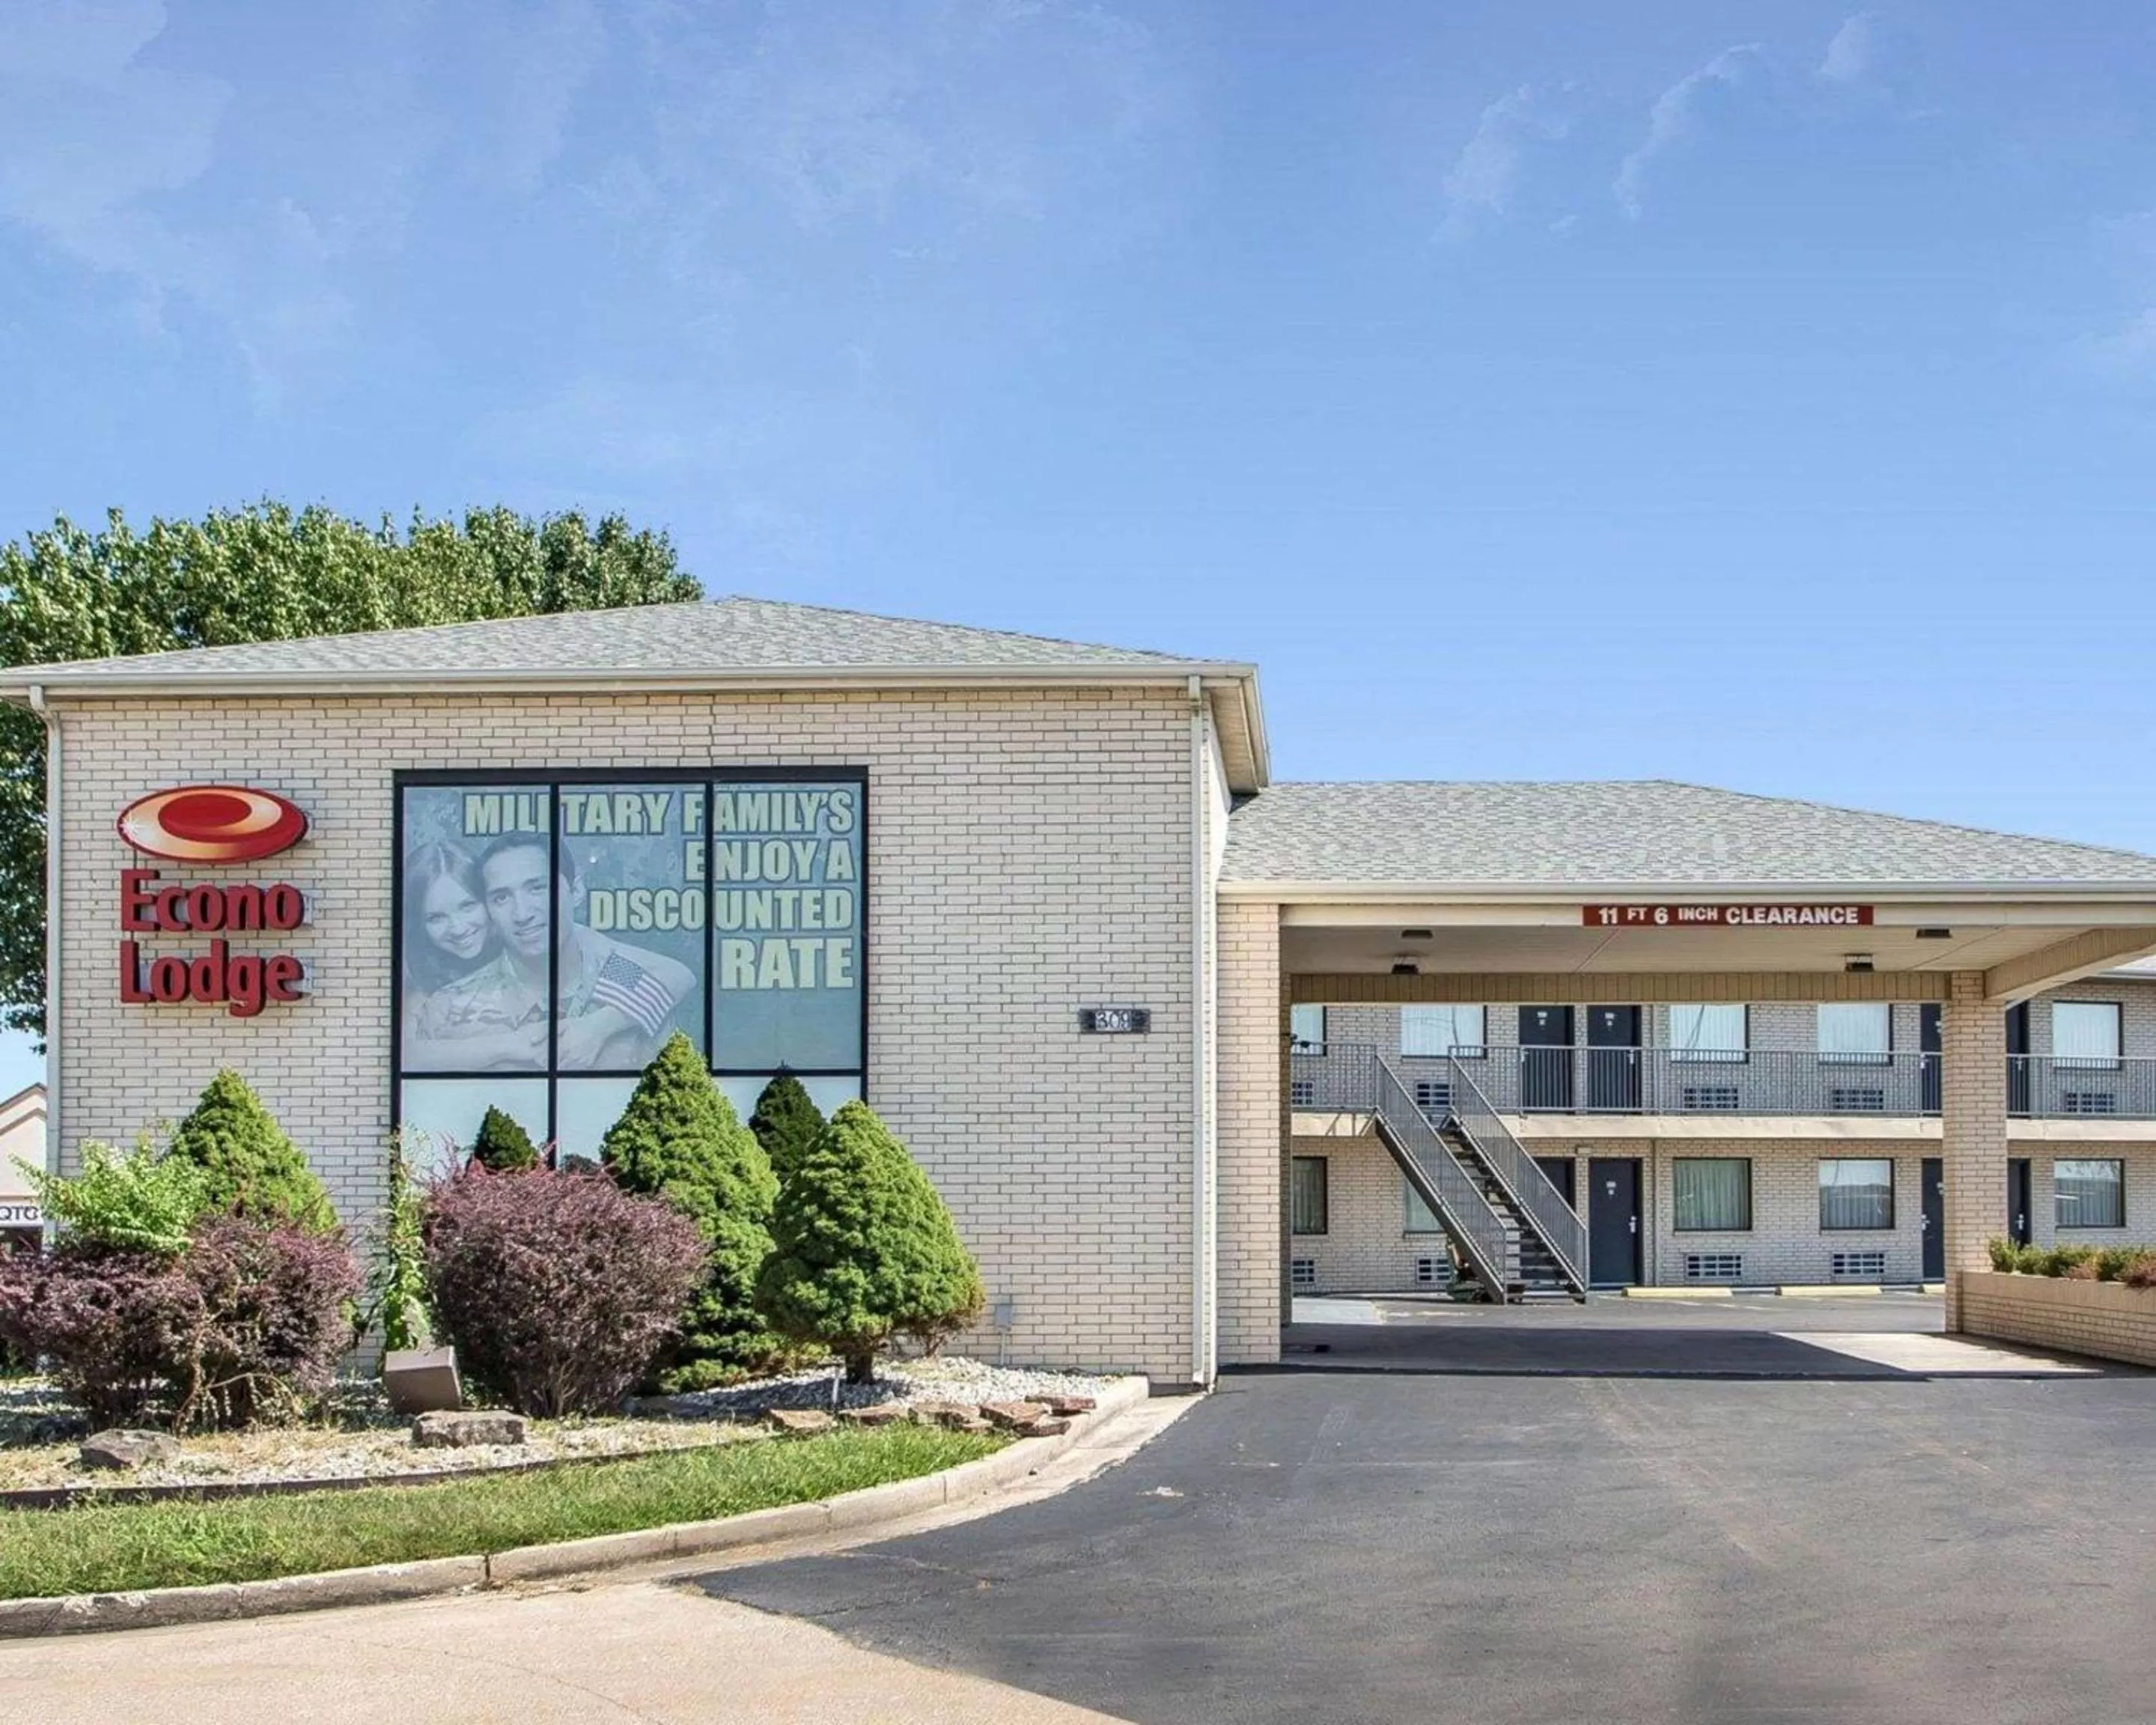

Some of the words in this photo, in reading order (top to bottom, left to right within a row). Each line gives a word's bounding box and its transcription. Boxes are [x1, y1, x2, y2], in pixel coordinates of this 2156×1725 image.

[682, 790, 854, 834] FAMILY'S
[685, 839, 820, 882] ENJOY
[824, 838, 856, 881] A
[121, 869, 305, 931] Econo
[588, 888, 854, 931] DISCOUNTED
[1598, 907, 1618, 924] 11
[1627, 907, 1646, 921] FT
[1654, 907, 1669, 924] 6
[1678, 907, 1718, 921] INCH
[1726, 907, 1859, 925] CLEARANCE
[121, 939, 305, 1017] Lodge
[720, 937, 855, 990] RATE
